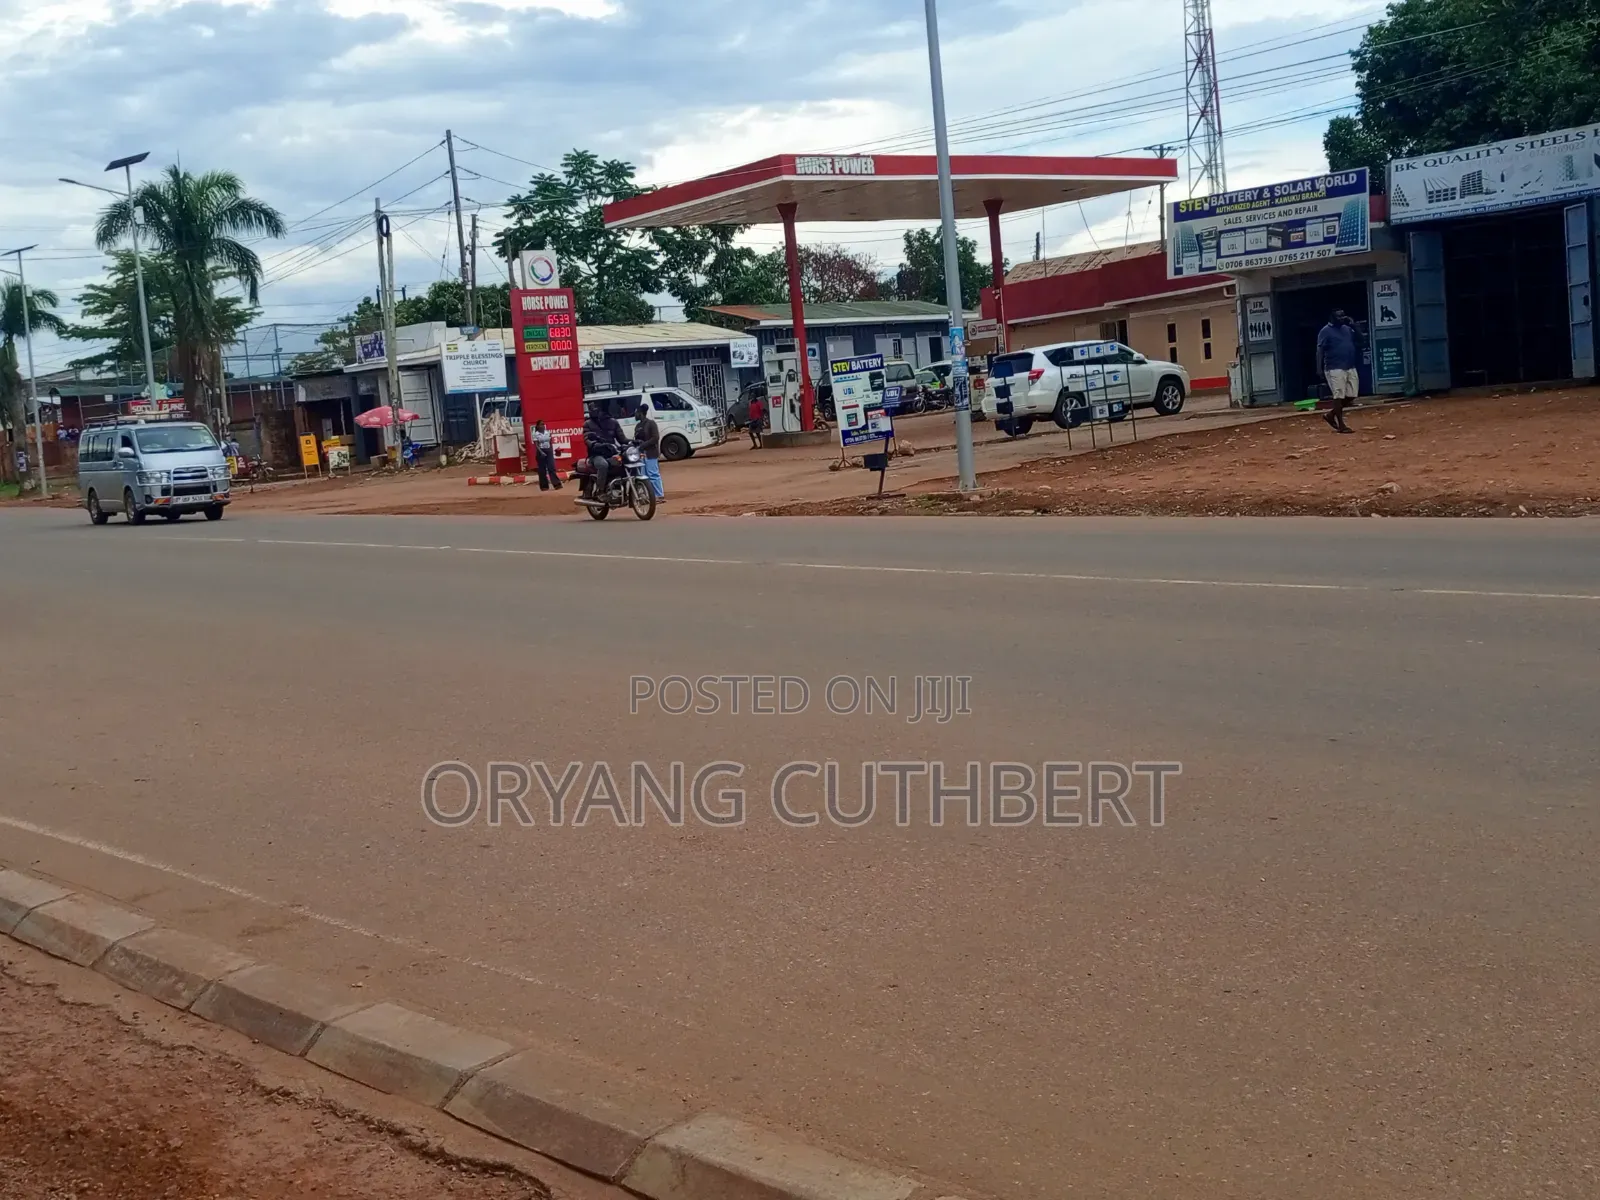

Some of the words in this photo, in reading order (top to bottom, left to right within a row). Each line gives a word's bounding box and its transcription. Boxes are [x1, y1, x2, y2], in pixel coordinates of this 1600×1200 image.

[1394, 161, 1419, 173] BK
[1423, 145, 1509, 168] QUALITY
[1514, 130, 1587, 152] STEELS
[795, 156, 833, 174] HORSE
[834, 157, 875, 174] POWER
[1210, 188, 1260, 207] BATTERY
[1262, 186, 1271, 199] &
[1274, 180, 1312, 196] SOLAR
[1315, 173, 1357, 191] WORLD
[1216, 202, 1251, 214] AUTHORIZED
[1252, 199, 1271, 209] AGENT
[1275, 195, 1301, 205] KAWUKU
[1301, 191, 1327, 201] BRANCH
[1246, 211, 1276, 223] SERVICES
[1277, 208, 1293, 217] AND
[1295, 204, 1318, 215] REPAIR
[1225, 260, 1243, 269] 0706
[1245, 256, 1273, 267] 863739
[1278, 252, 1298, 263] 0765
[1299, 250, 1314, 261] 217
[1317, 248, 1332, 258] 507
[521, 296, 544, 311] HORSE
[544, 295, 569, 310] POWER
[547, 313, 570, 325] 6539
[549, 327, 571, 338] 6830
[550, 340, 572, 351] 0000
[445, 353, 470, 361] TRIPPLE
[471, 352, 503, 360] BLESSINGS
[832, 361, 850, 373] STEV
[851, 357, 882, 371] BATTERY
